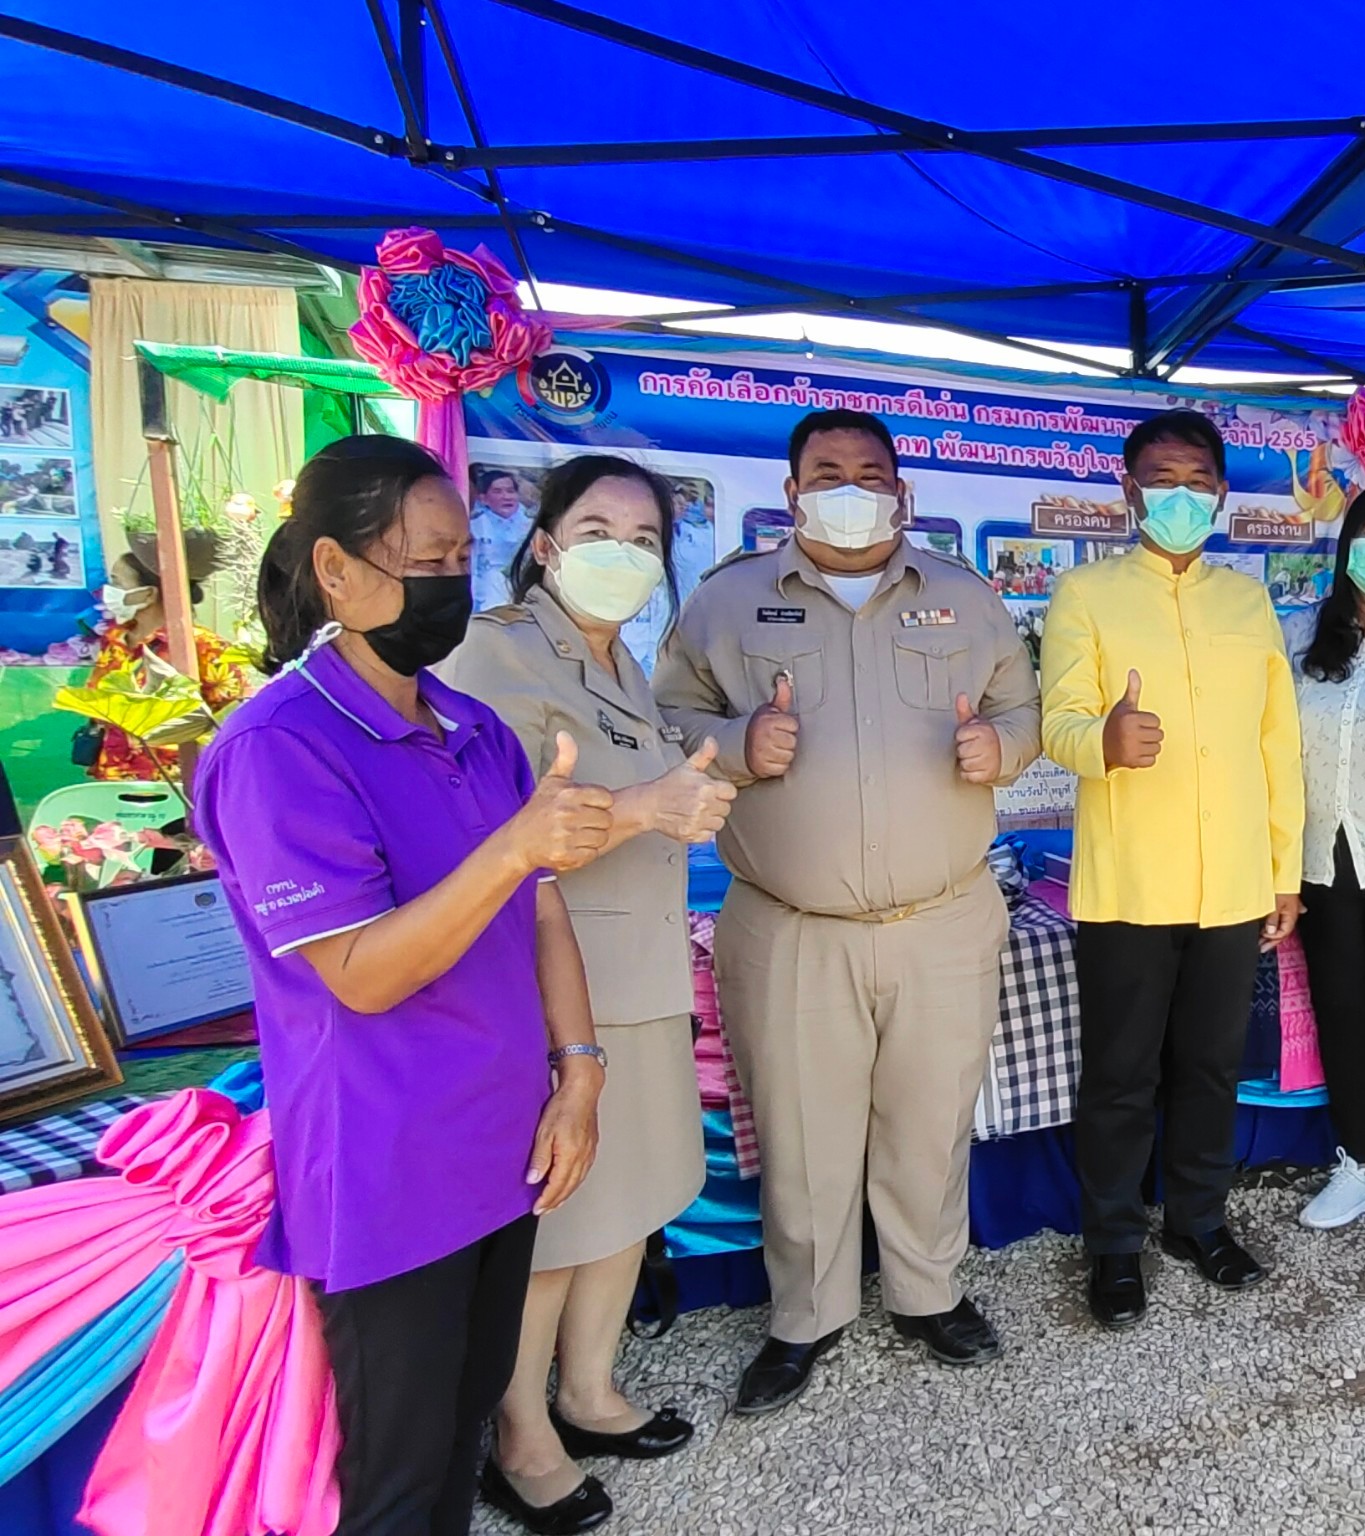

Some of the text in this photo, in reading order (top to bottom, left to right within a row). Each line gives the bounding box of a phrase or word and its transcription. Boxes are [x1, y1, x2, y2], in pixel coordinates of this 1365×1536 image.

[640, 368, 967, 421] การคัดเลือกข้าราชการดีเด่น
[1269, 429, 1318, 450] 2565
[1054, 513, 1111, 529] ครองคน
[1246, 522, 1302, 538] ครองงาน
